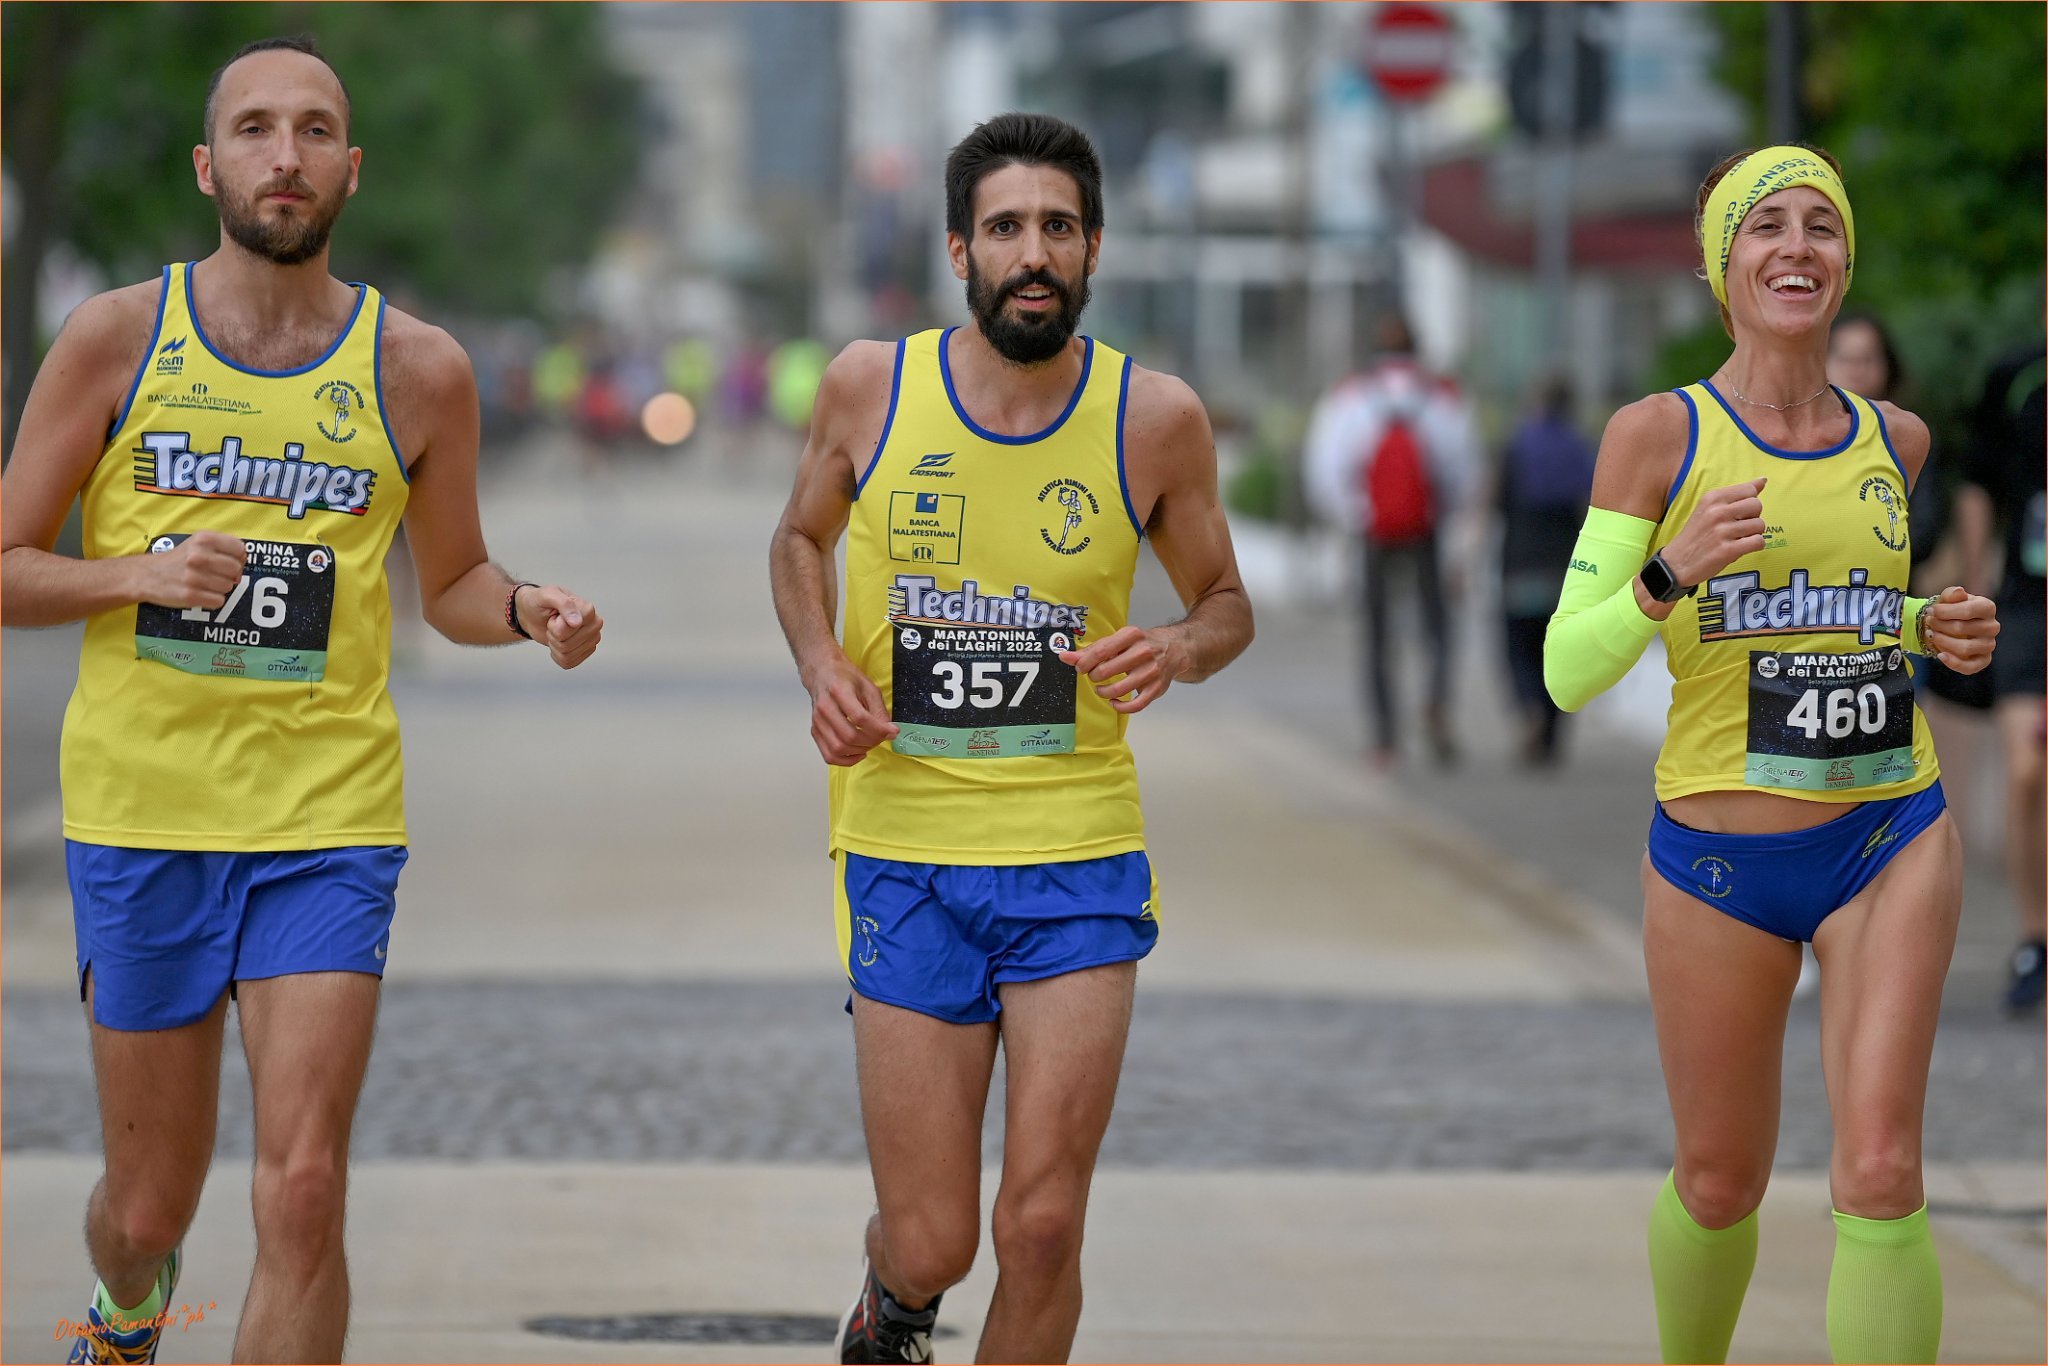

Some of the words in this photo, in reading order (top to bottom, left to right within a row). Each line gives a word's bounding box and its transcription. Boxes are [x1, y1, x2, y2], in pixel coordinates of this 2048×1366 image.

[1745, 158, 1817, 208] CESENATIC
[1721, 201, 1737, 276] CESENA
[148, 394, 178, 403] BANCA
[182, 395, 252, 409] MALATESTIANA
[142, 432, 373, 519] Technipes
[909, 469, 956, 479] GIOSPORT
[1038, 479, 1064, 503] ATLETICA
[1064, 478, 1089, 494] RIMINI
[1086, 492, 1099, 514] NORD
[909, 518, 940, 527] BANCA
[893, 528, 956, 539] MALATESTIANA
[1040, 528, 1091, 555] SANTARCANGELO
[203, 626, 261, 646] MIRCO
[927, 639, 950, 650] dei
[1006, 641, 1043, 652] 2022
[268, 663, 308, 673] OTTAVIANI
[1787, 665, 1811, 677] dei
[1861, 661, 1885, 675] 2022
[930, 660, 1040, 709] 357
[1786, 682, 1887, 739] 460
[1020, 738, 1061, 748] OTTAVIANI
